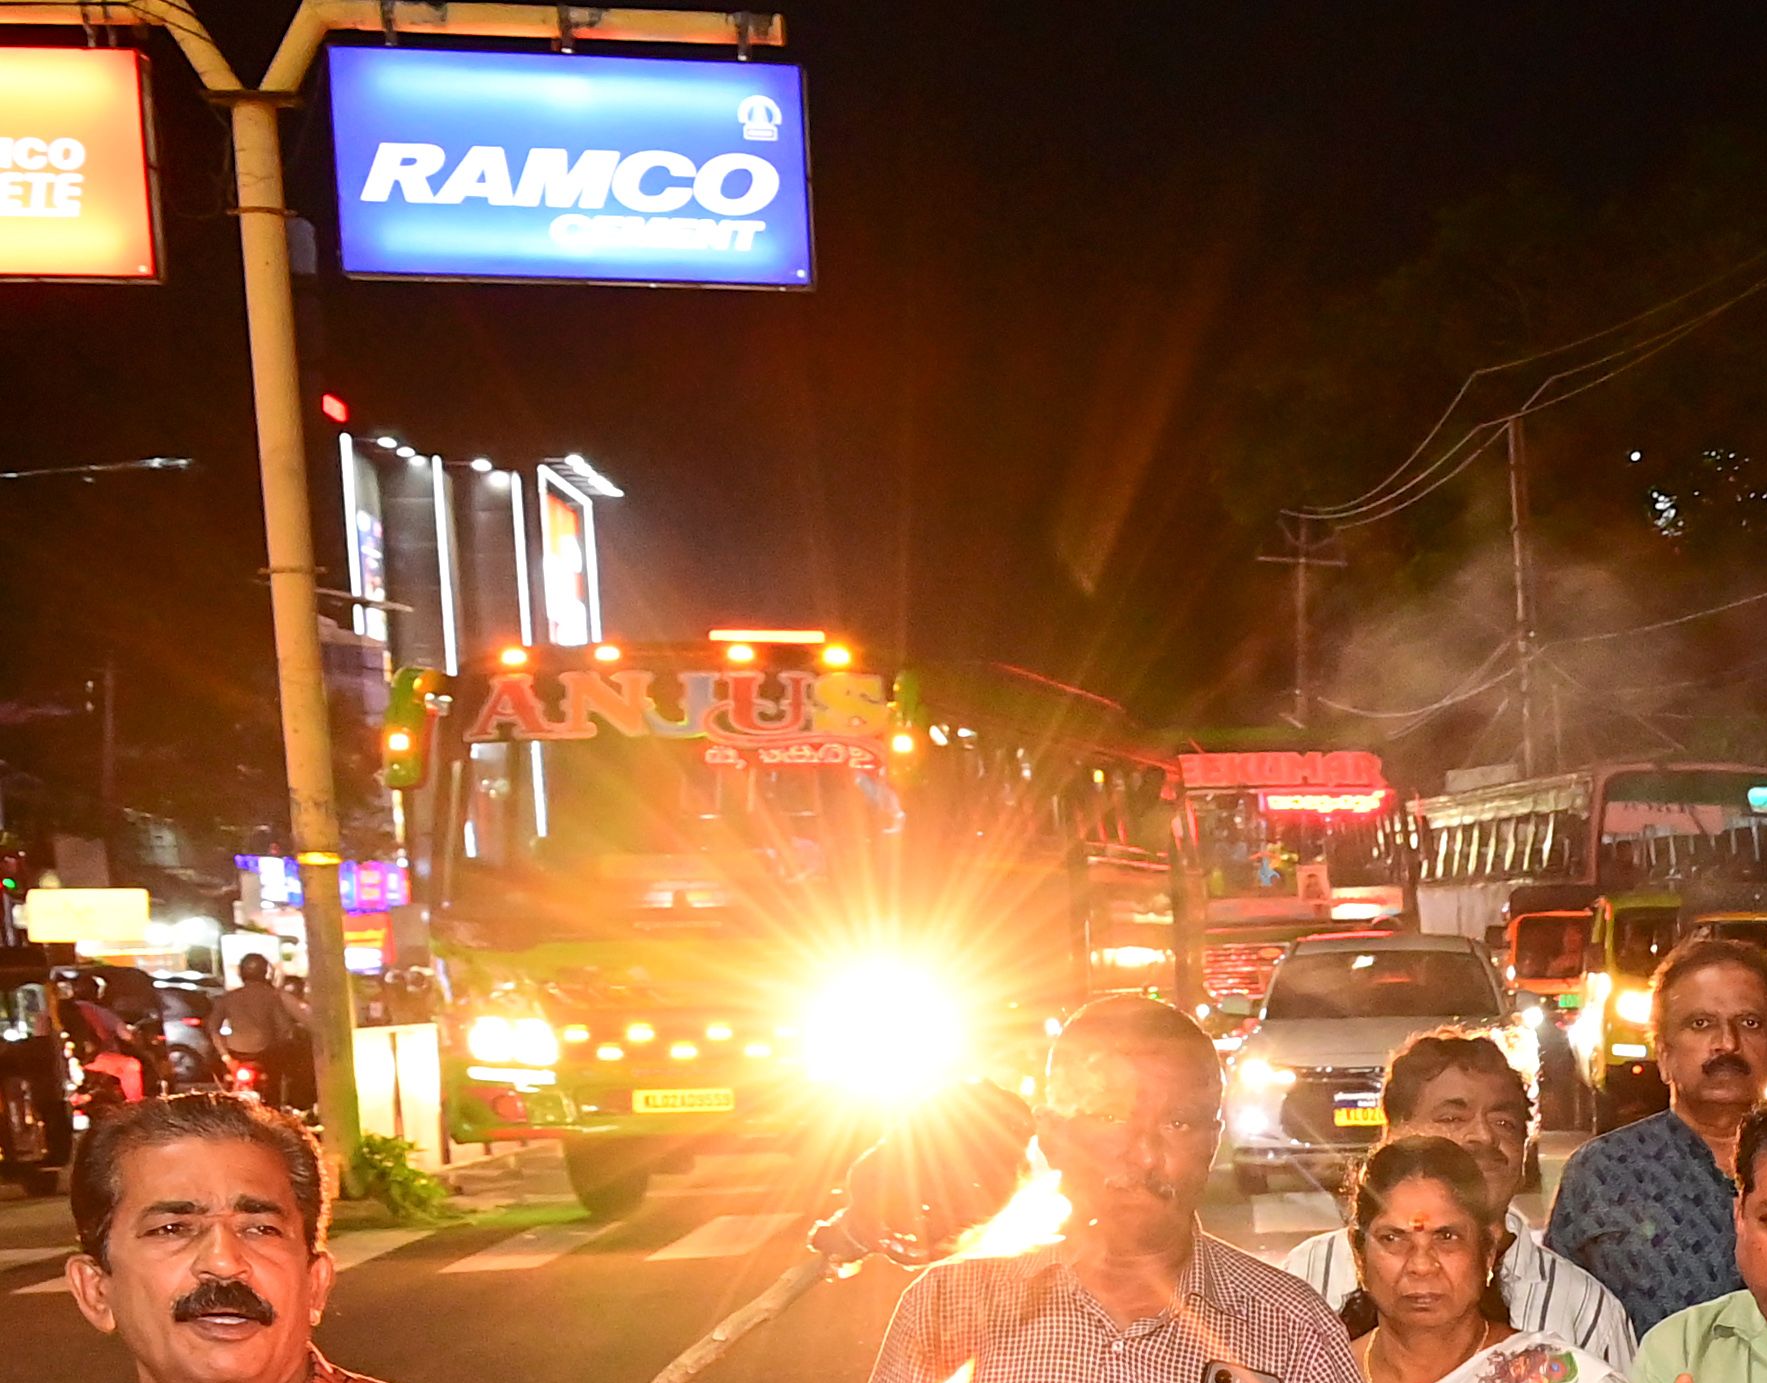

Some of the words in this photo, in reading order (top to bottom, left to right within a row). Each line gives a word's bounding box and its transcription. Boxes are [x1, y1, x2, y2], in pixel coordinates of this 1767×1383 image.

[360, 142, 780, 216] RAMCO
[550, 213, 766, 251] CEMENT
[462, 671, 890, 744] ANJUS
